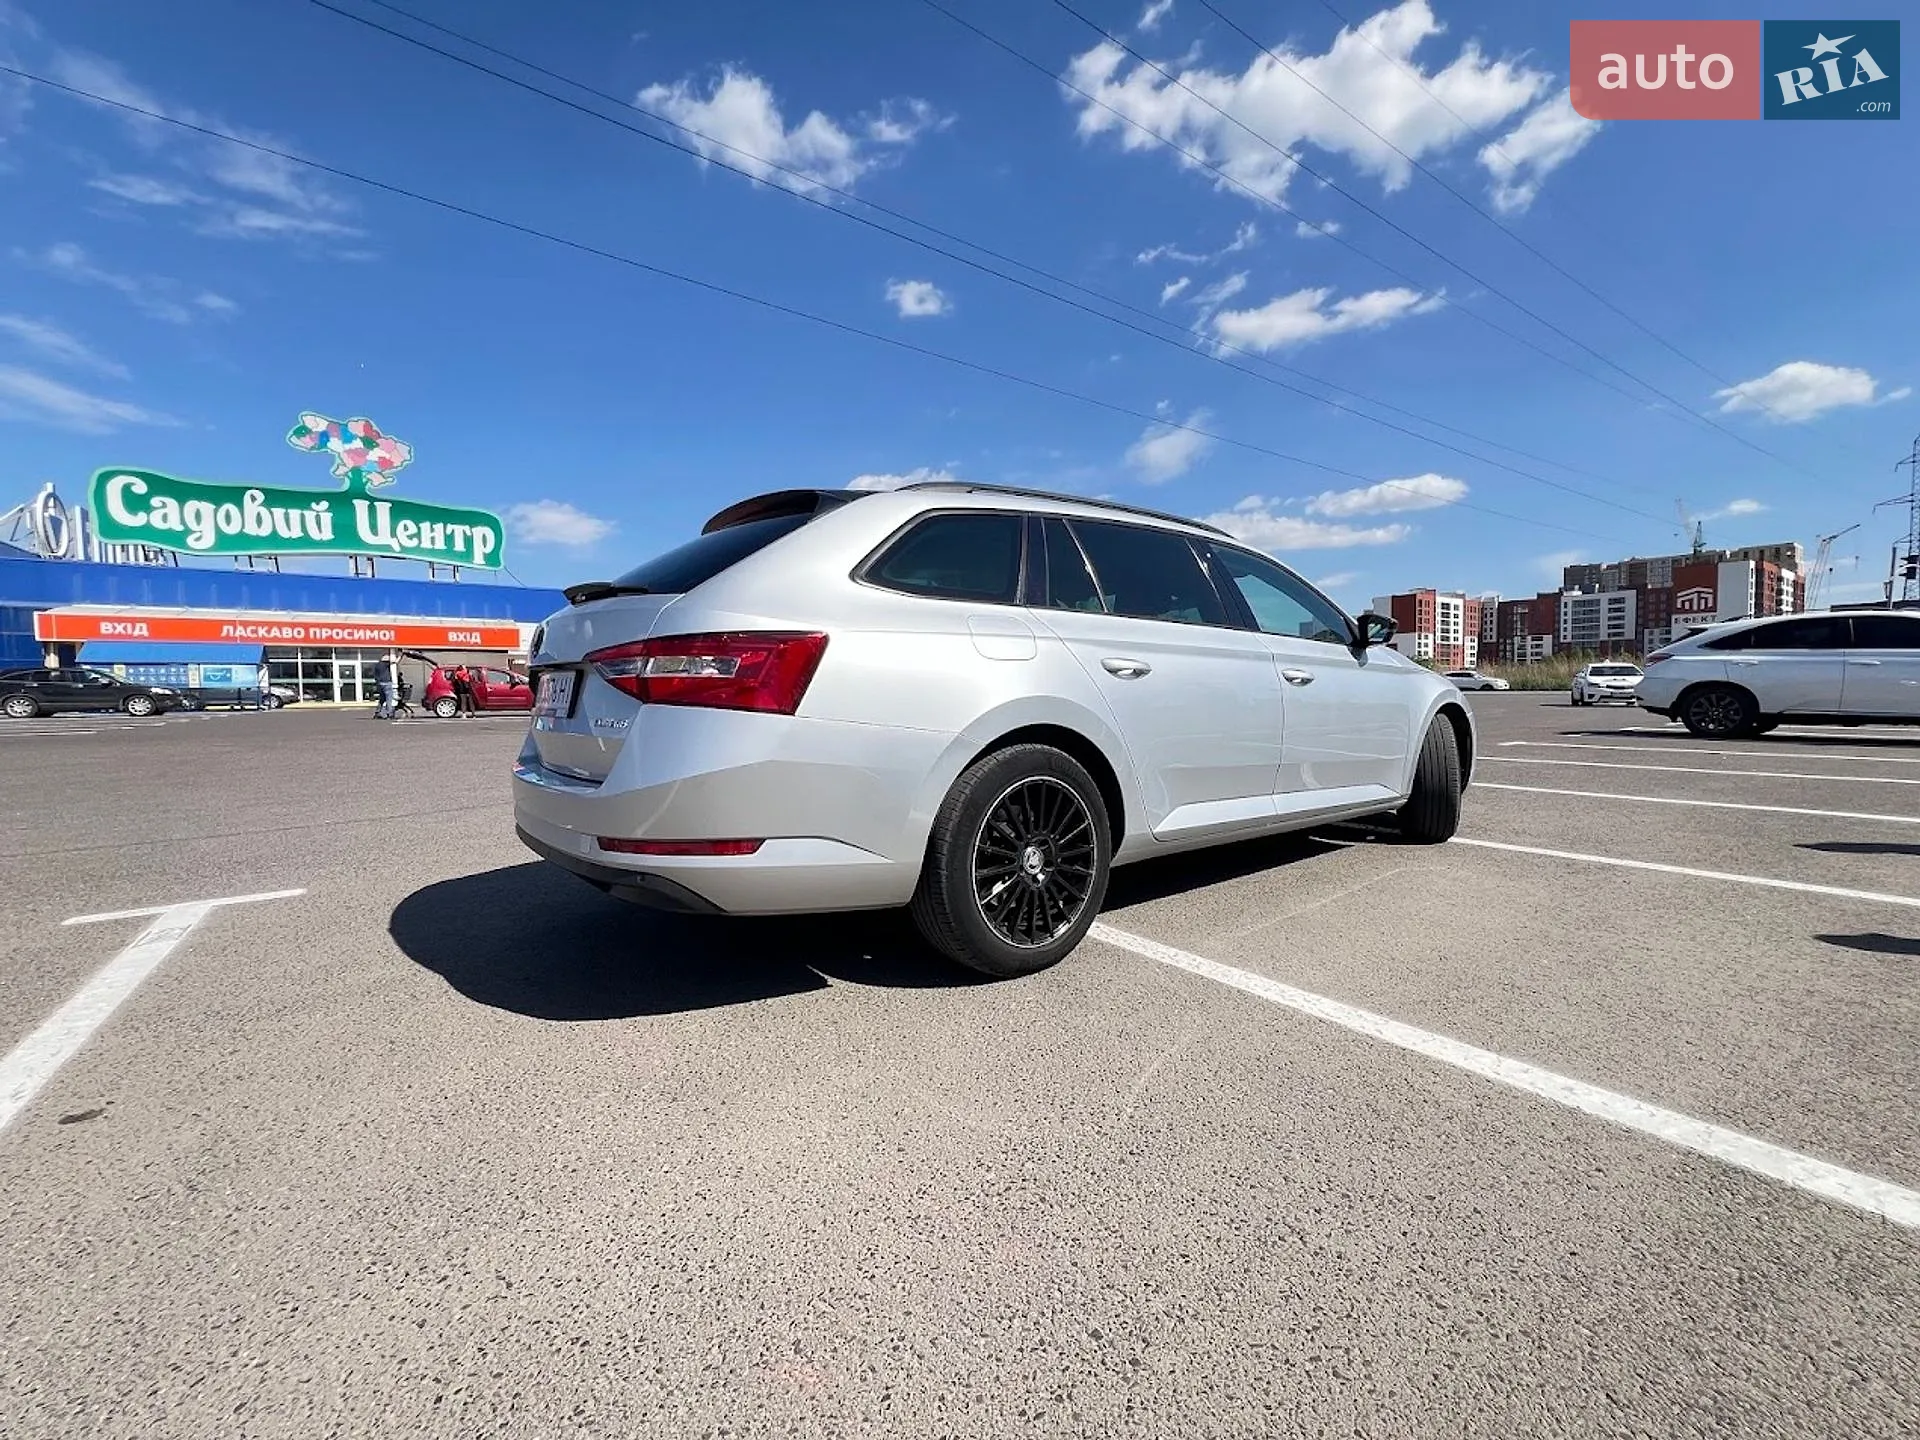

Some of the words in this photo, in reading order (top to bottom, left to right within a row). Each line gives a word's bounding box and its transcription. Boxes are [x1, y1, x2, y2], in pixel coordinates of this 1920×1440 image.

[106, 475, 334, 549] Садовий
[353, 499, 496, 564] Центр
[100, 621, 149, 637] ВХІД
[221, 624, 304, 640] ЛАСКАВО
[309, 627, 395, 642] ПРОСИМО!
[448, 631, 482, 645] ВХІД
